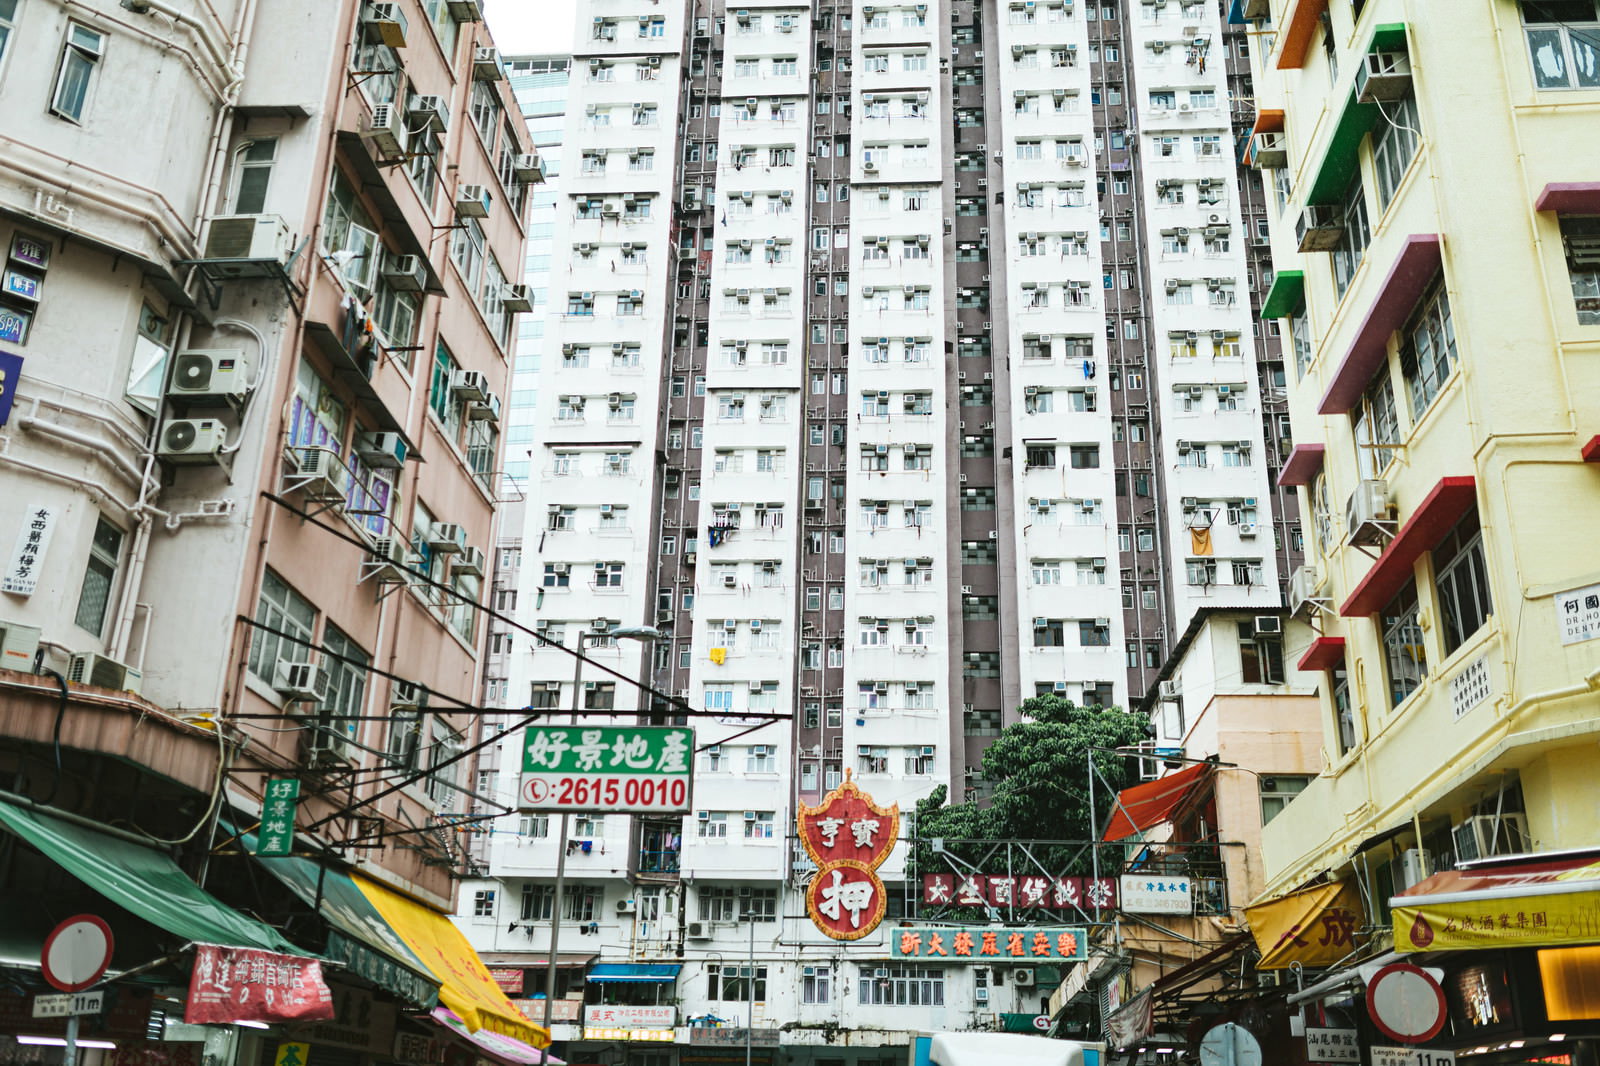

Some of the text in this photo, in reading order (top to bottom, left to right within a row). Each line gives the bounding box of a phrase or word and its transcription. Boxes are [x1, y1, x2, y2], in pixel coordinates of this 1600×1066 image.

[0, 314, 20, 335] SPA
[527, 730, 688, 773] 好景地產
[624, 778, 685, 806] 0010
[263, 782, 293, 853] 好景地產
[818, 869, 874, 929] 押
